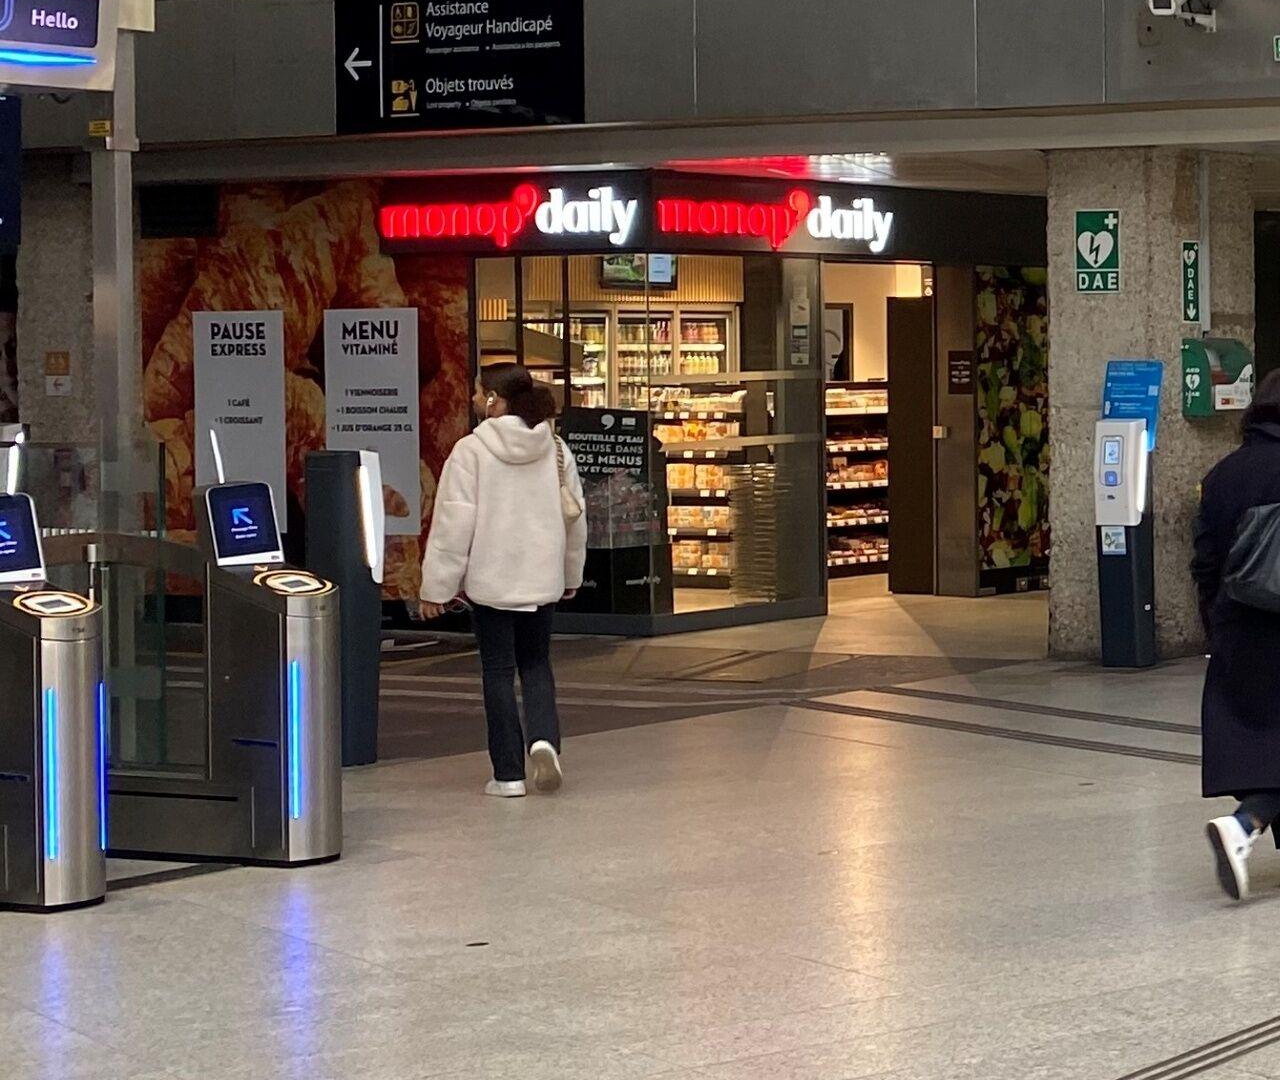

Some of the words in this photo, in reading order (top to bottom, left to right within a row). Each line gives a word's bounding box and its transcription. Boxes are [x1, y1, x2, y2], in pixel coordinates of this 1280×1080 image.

[426, 0, 489, 16] Assistance
[31, 9, 79, 29] Hello
[426, 22, 483, 40] Voyageur
[486, 15, 553, 36] Handicapé
[426, 78, 465, 96] Objets
[469, 74, 514, 91] trouvés
[1078, 272, 1119, 290] DAE
[211, 323, 265, 340] PAUSE
[342, 320, 399, 340] MENU
[211, 343, 266, 356] EXPRESS
[342, 340, 398, 355] VITAMINÉ
[568, 433, 615, 442] BOUTEILLE
[616, 445, 643, 454] DANS
[598, 455, 642, 465] MENUS
